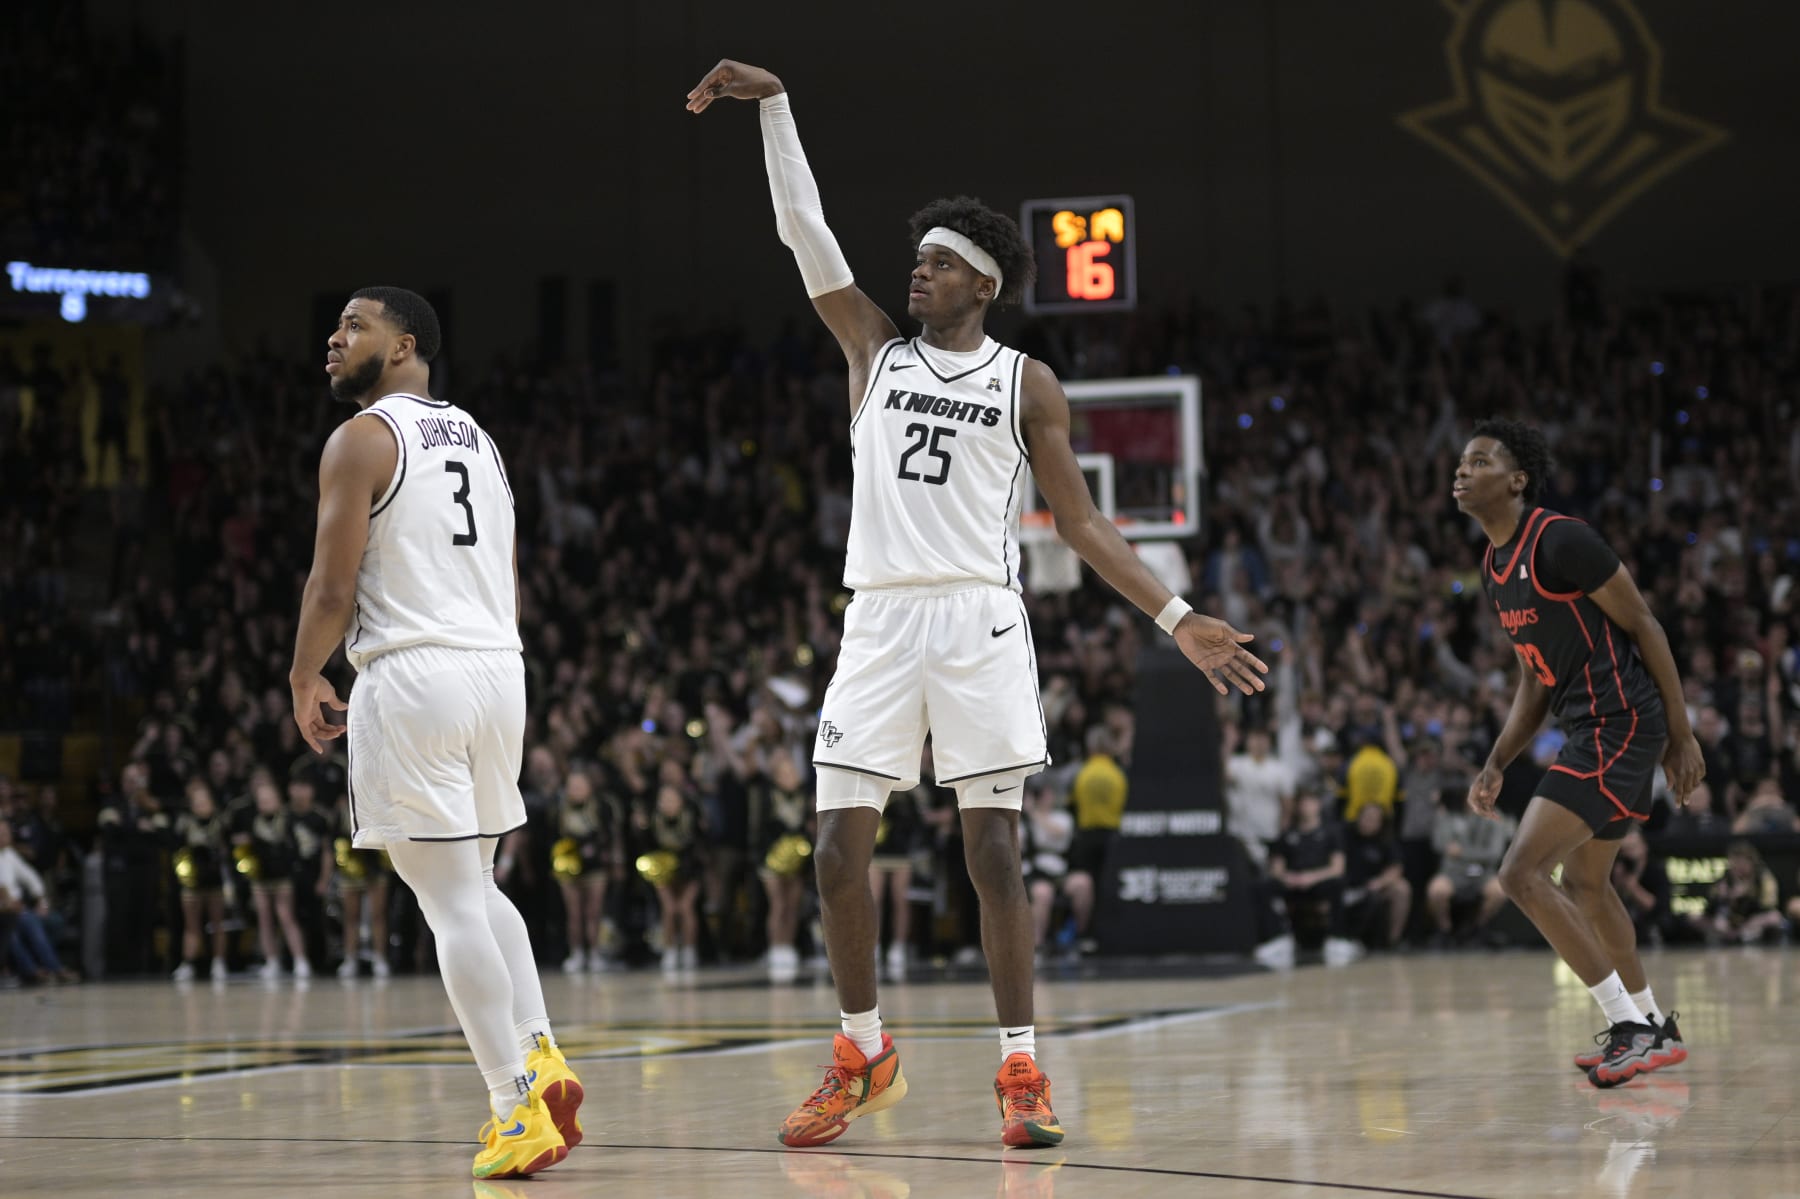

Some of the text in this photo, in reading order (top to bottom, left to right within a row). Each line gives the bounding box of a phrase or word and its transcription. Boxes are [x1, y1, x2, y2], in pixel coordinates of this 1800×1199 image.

[6, 261, 151, 298] Turnovers
[1066, 241, 1115, 300] 16
[884, 389, 1002, 427] KNIGHTS
[415, 417, 480, 454] JOHNSON
[898, 422, 957, 485] 25
[445, 460, 478, 546] 3
